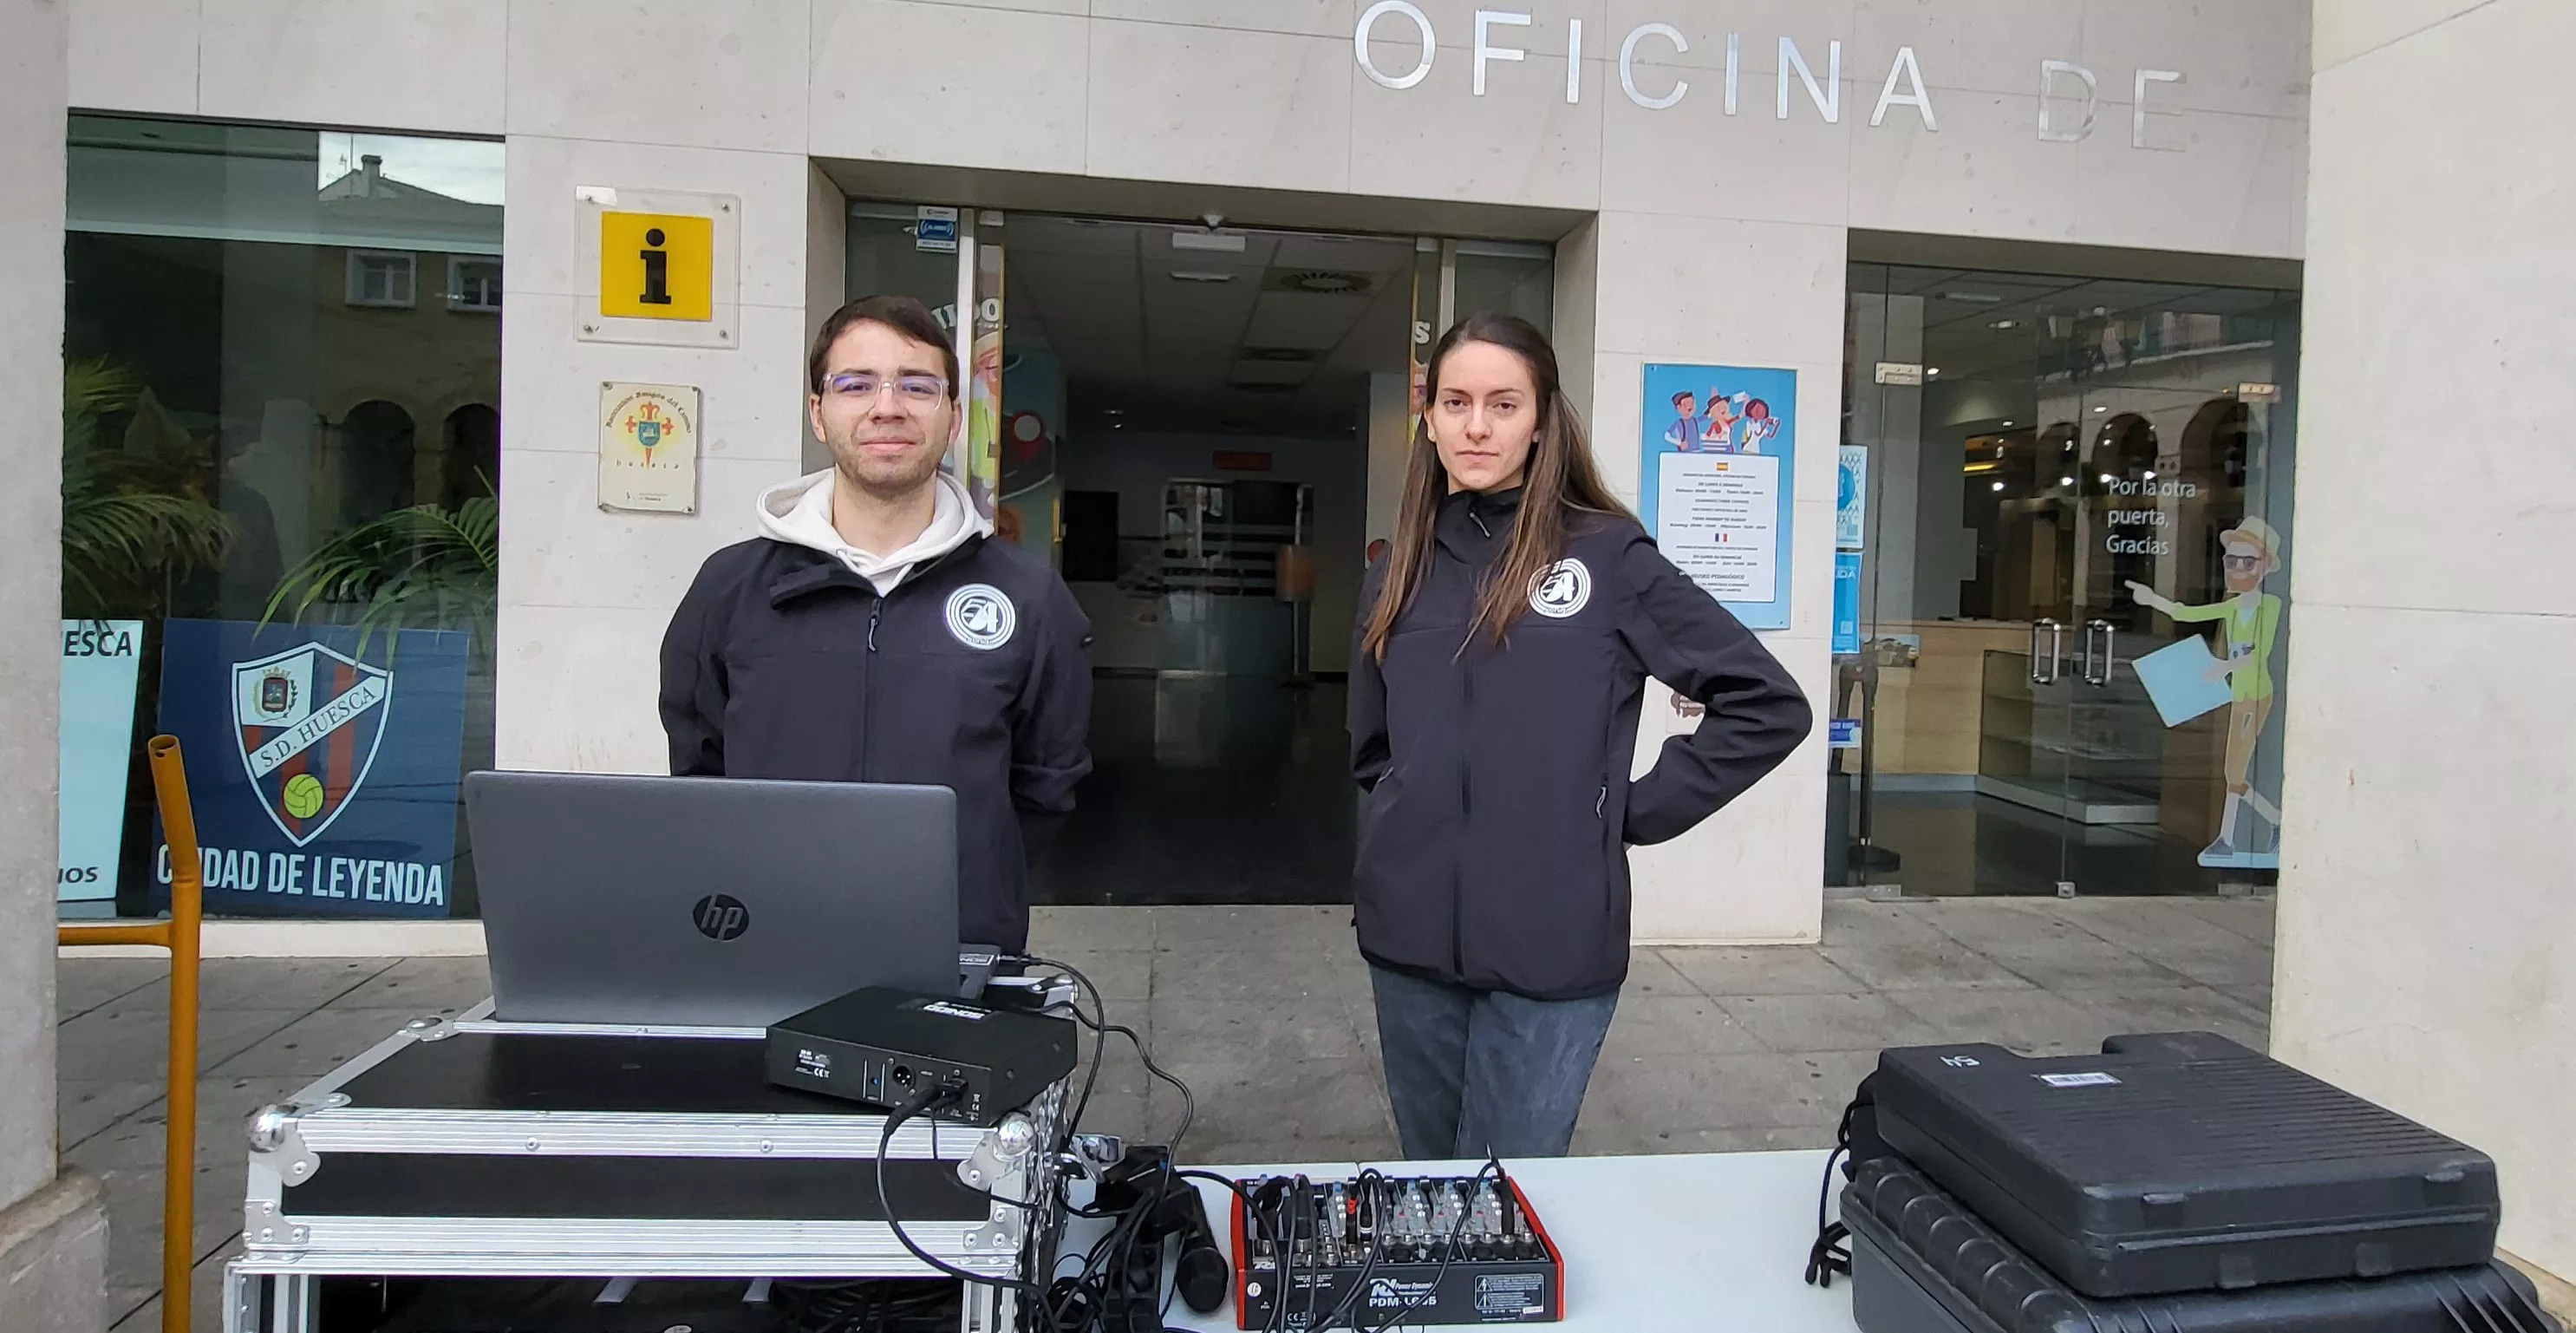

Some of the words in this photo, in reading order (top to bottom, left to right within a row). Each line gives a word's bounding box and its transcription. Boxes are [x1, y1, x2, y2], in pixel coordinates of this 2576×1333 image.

[1354, 0, 1939, 132] OFICINA
[2038, 59, 2187, 152] DE
[2109, 476, 2138, 495] Por
[2142, 475, 2156, 496] la
[2161, 480, 2195, 498] otra
[2108, 508, 2168, 528] puerta,
[2106, 534, 2169, 554] Gracias
[62, 631, 132, 657] ESCA
[260, 740, 297, 768] S.D.
[297, 685, 376, 744] HUESCA
[157, 844, 260, 892] CDAD
[268, 852, 305, 895] DE
[312, 856, 444, 906] LEYENDA
